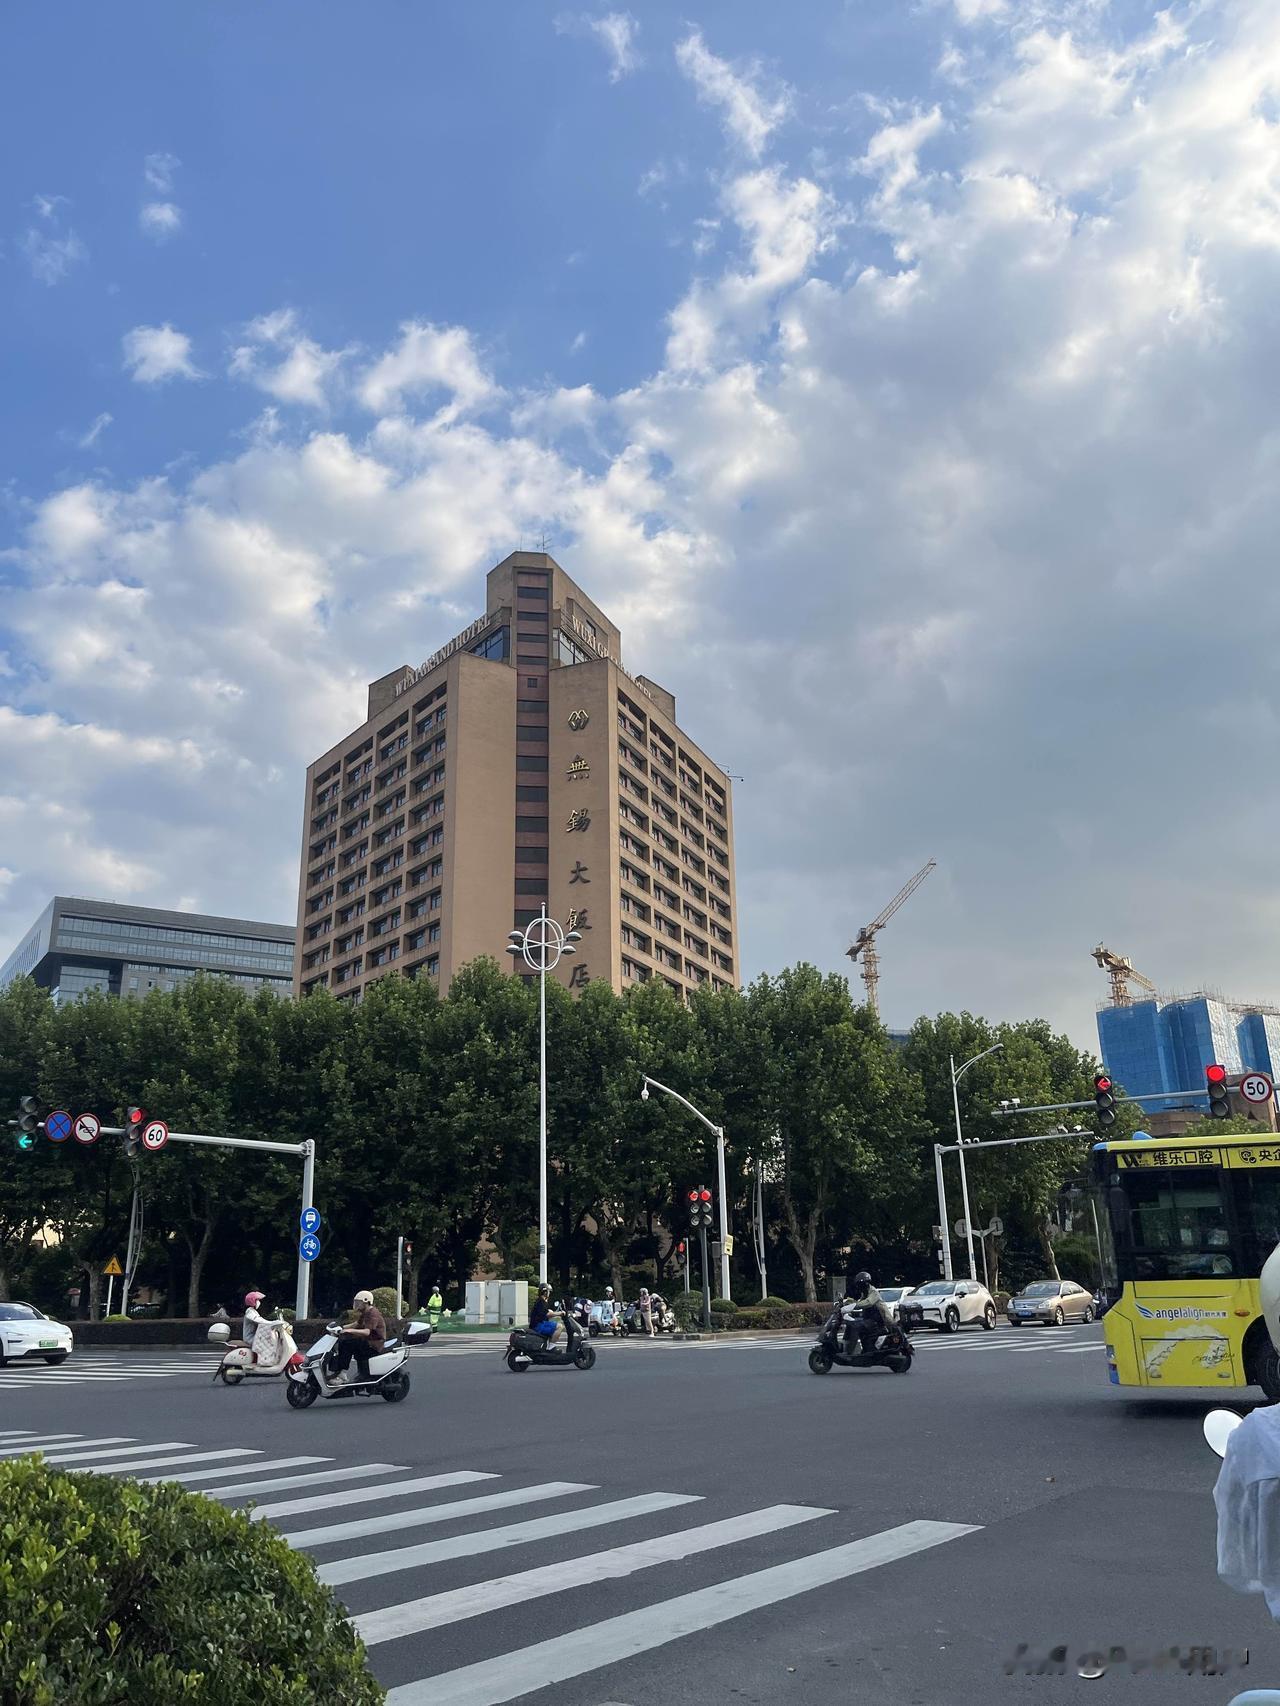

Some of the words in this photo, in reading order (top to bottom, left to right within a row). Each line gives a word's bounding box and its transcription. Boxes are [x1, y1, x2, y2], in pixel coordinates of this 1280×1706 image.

[454, 612, 491, 651] HOTEL
[572, 615, 597, 651] WUXI
[566, 754, 592, 988] 無錫大飯店
[1246, 1081, 1266, 1096] 50
[148, 1129, 163, 1142] 60
[1153, 1150, 1214, 1165] 维乐口腔
[1155, 1307, 1205, 1321] angelalign
